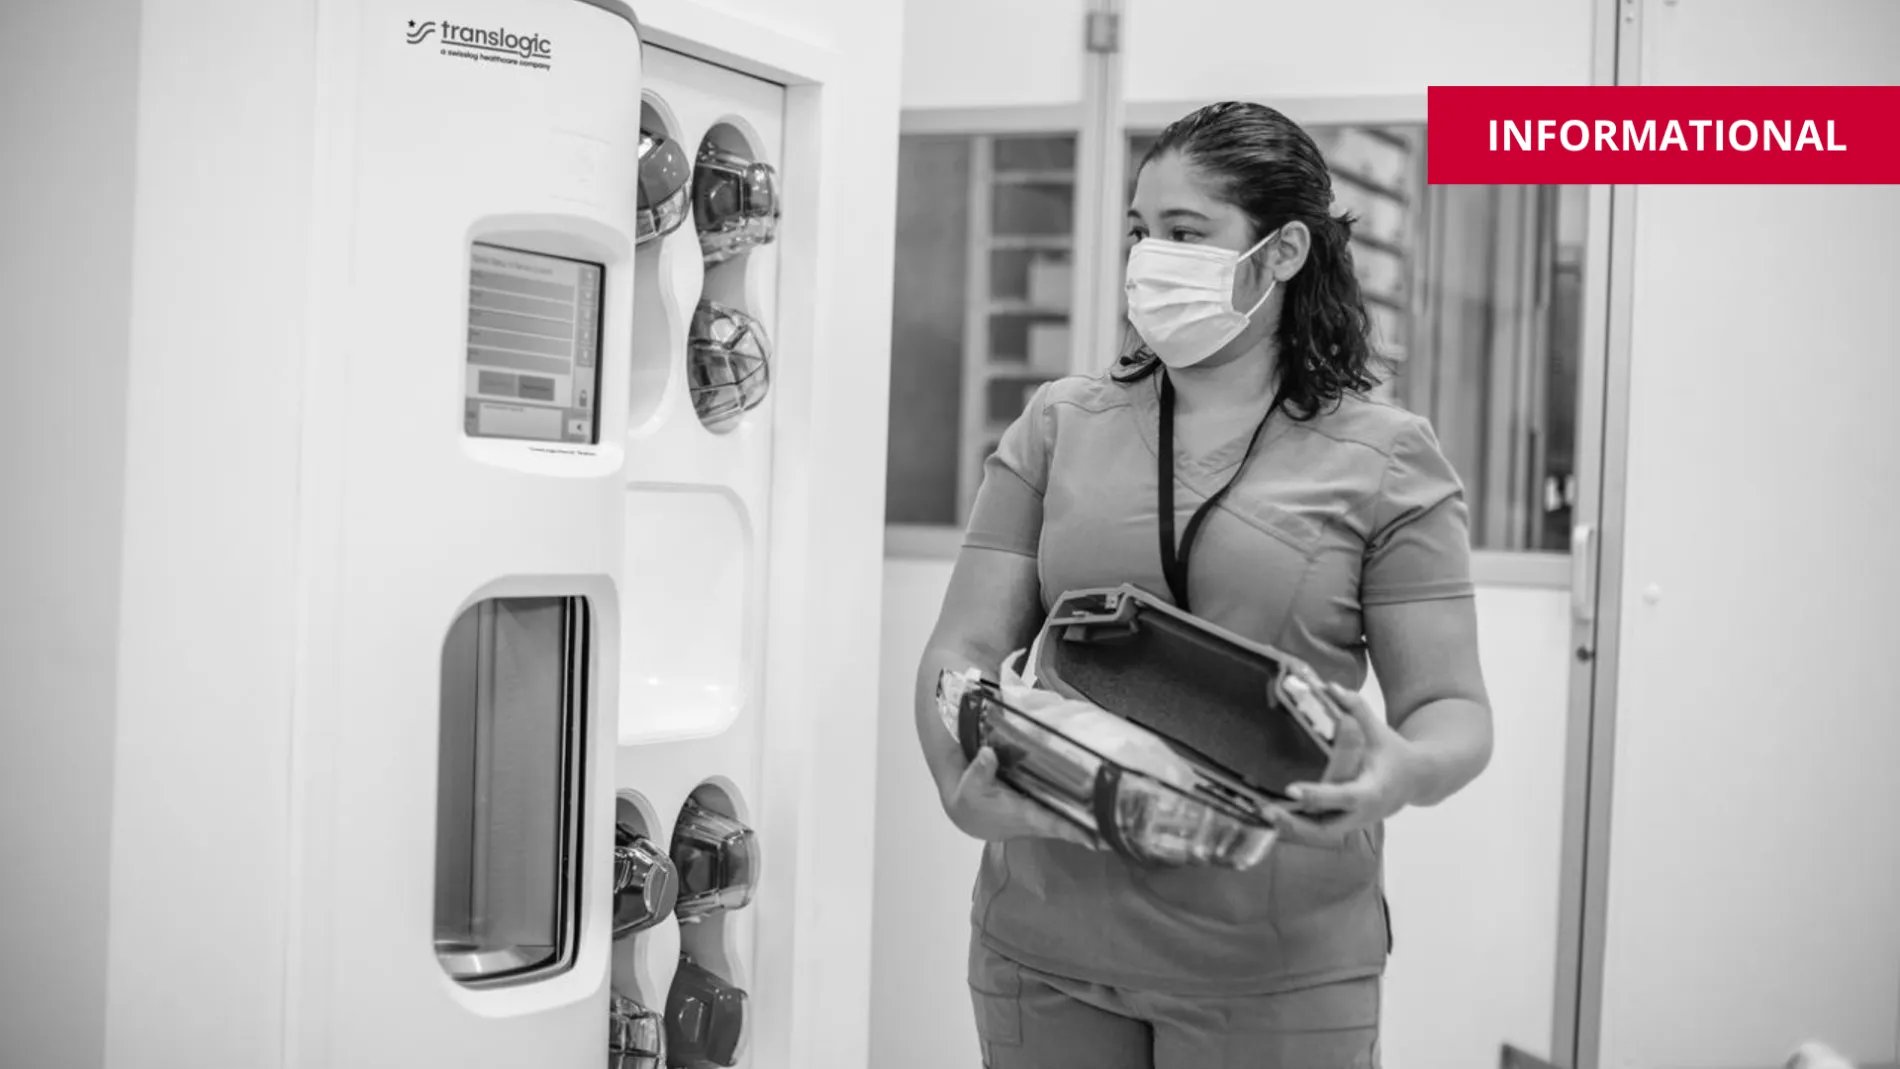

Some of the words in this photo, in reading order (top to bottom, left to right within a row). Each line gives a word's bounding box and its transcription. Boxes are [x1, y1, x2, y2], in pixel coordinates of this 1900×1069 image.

[441, 21, 551, 58] translogic
[448, 50, 479, 60] swisslog
[480, 54, 518, 65] healthcare
[519, 60, 551, 71] company
